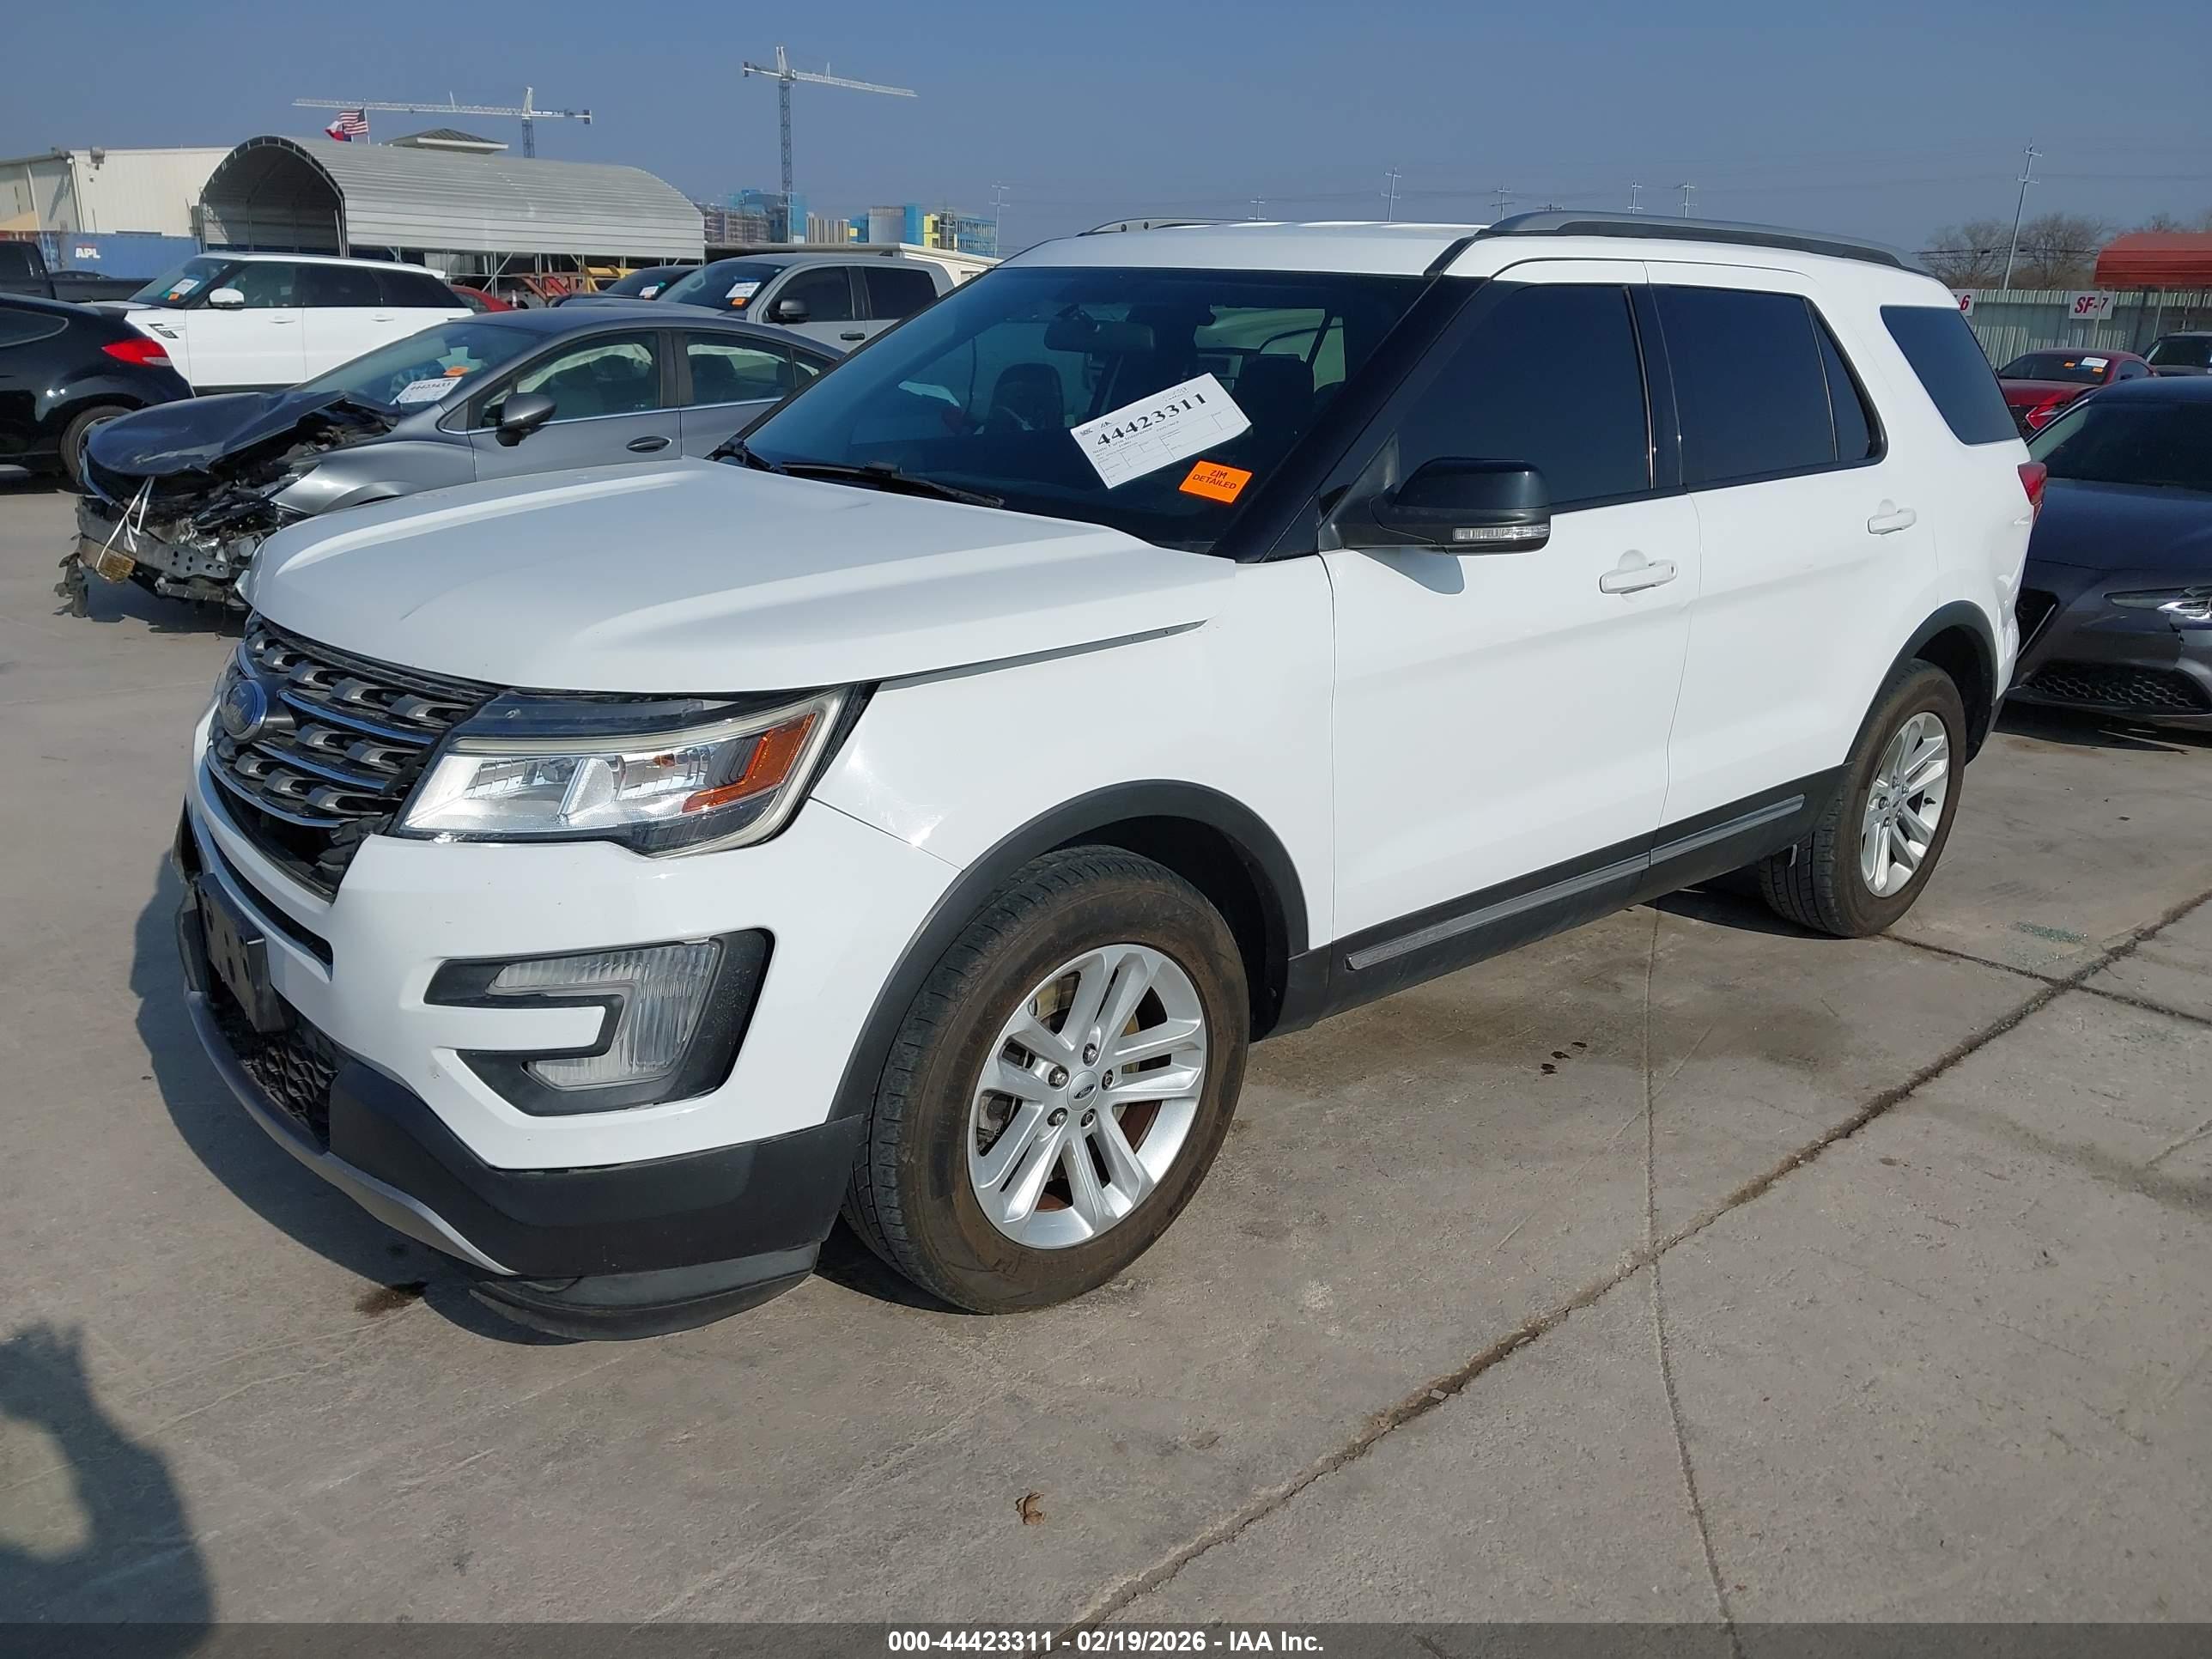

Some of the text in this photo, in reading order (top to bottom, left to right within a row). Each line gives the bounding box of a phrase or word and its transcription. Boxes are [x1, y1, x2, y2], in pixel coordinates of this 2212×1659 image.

[76, 247, 100, 258] APL
[2075, 296, 2109, 314] SF-7
[1097, 393, 1206, 446] 44423311
[1193, 474, 1237, 489] DETAILED
